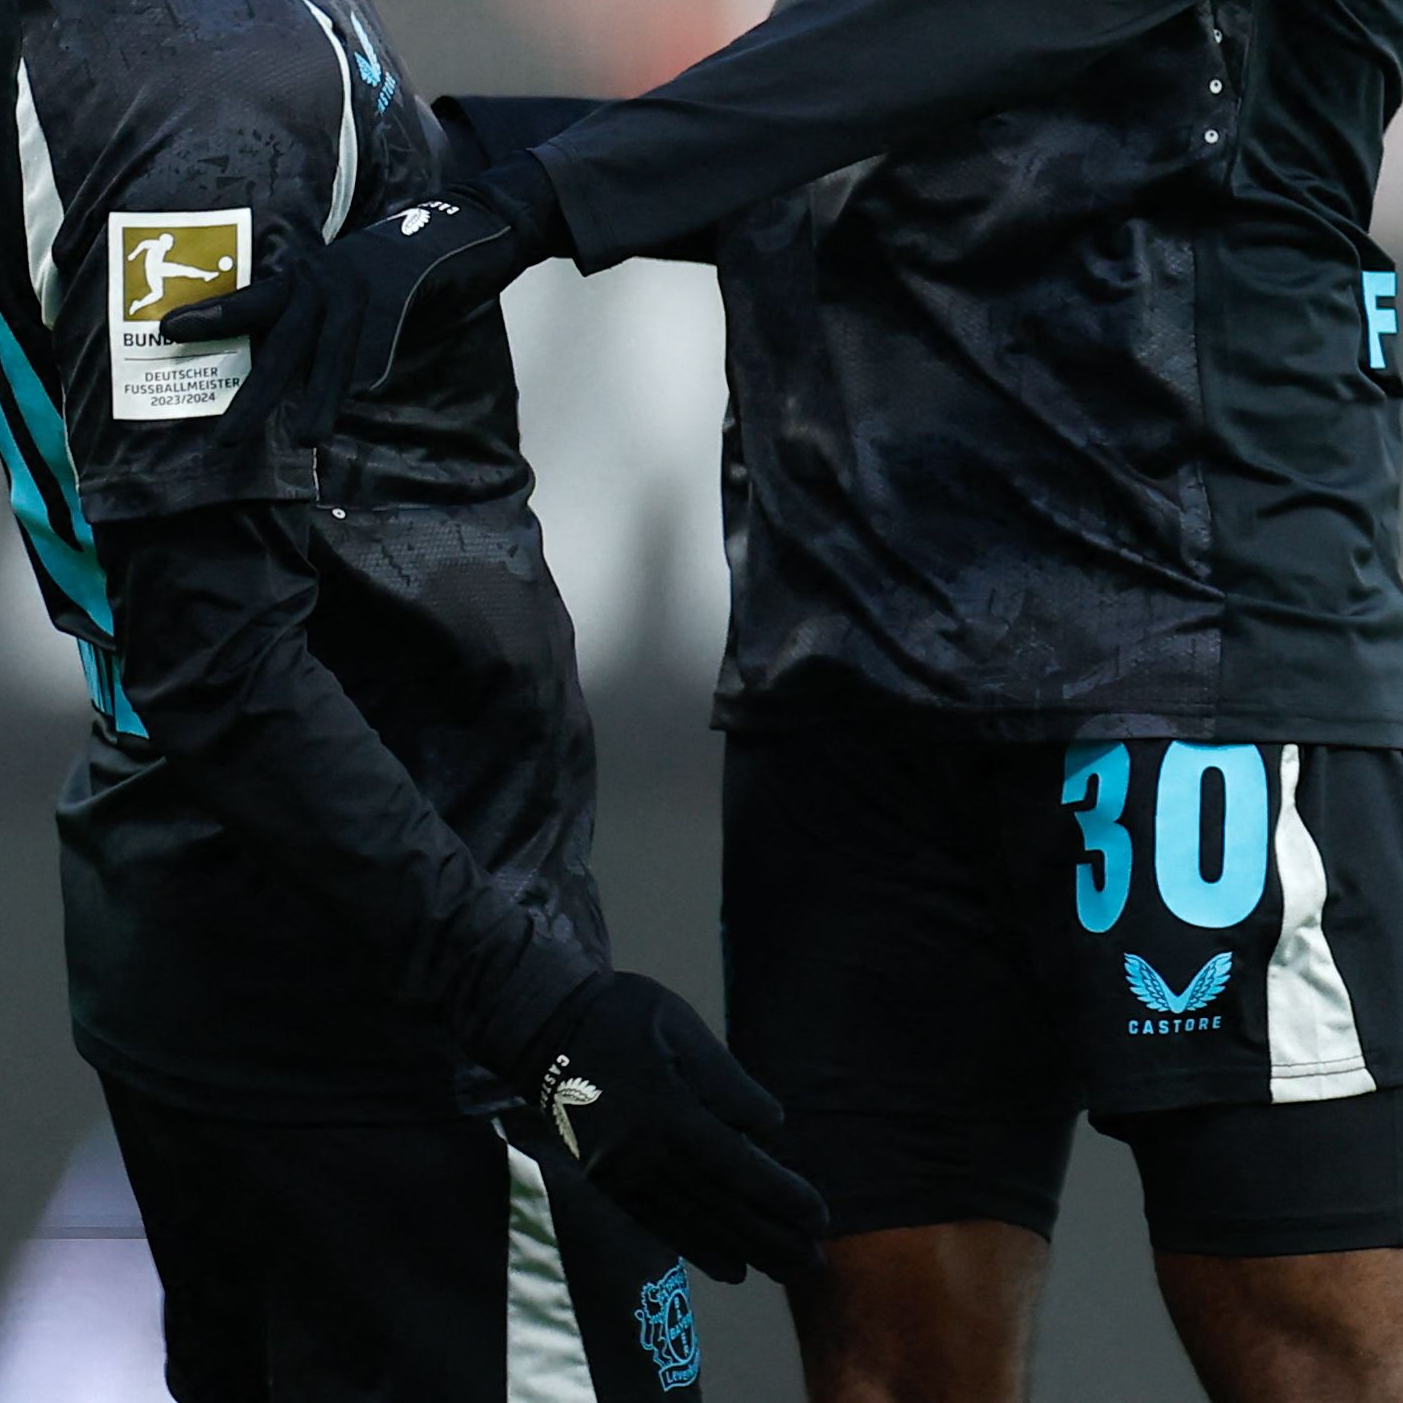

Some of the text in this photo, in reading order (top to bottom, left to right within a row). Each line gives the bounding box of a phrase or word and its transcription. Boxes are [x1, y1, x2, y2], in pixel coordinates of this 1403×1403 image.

[144, 366, 219, 383] DEUTSCHER
[123, 377, 241, 395] FUSSBALLMEISTER
[150, 392, 217, 407] 2023/2024
[1060, 739, 1269, 933] 30
[1128, 1016, 1223, 1035] CASTORE
